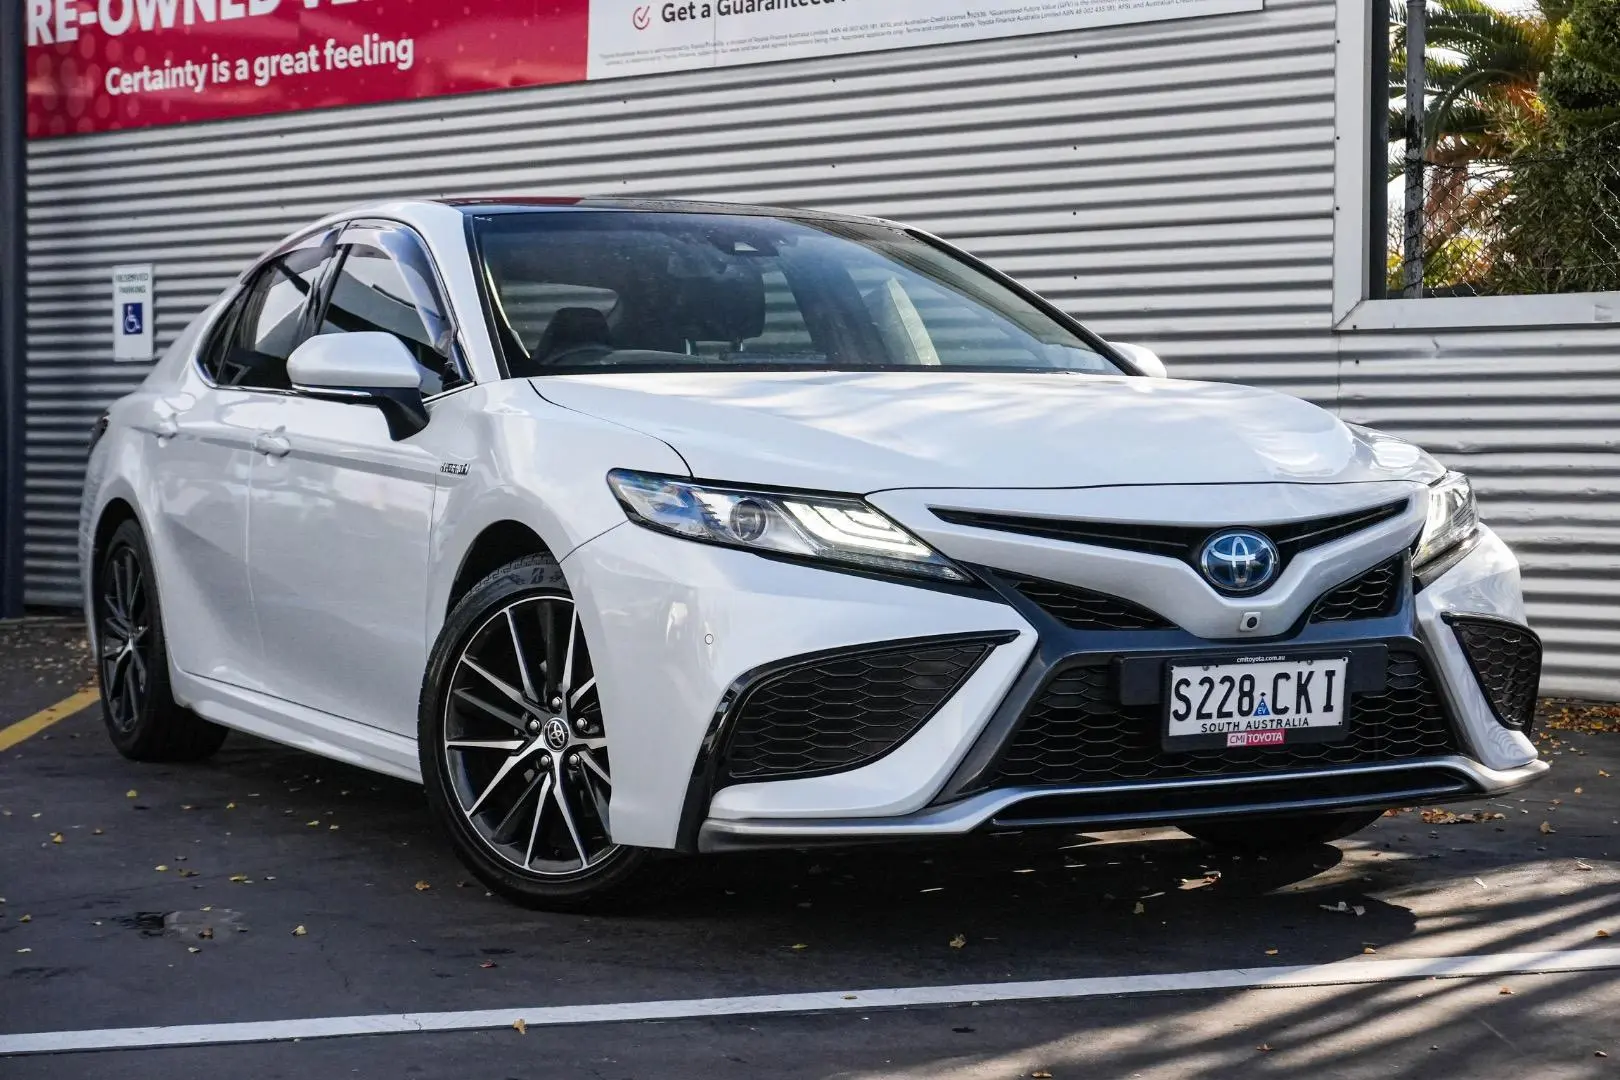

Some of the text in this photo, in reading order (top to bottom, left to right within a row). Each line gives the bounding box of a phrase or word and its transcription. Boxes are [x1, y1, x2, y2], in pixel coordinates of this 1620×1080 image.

[661, 3, 696, 23] Get
[700, 3, 711, 18] a
[105, 32, 414, 96] Certainty is a great feeling
[1201, 717, 1310, 733] SOUTH AUSTRALIA
[1247, 732, 1284, 743] TOYOTA
